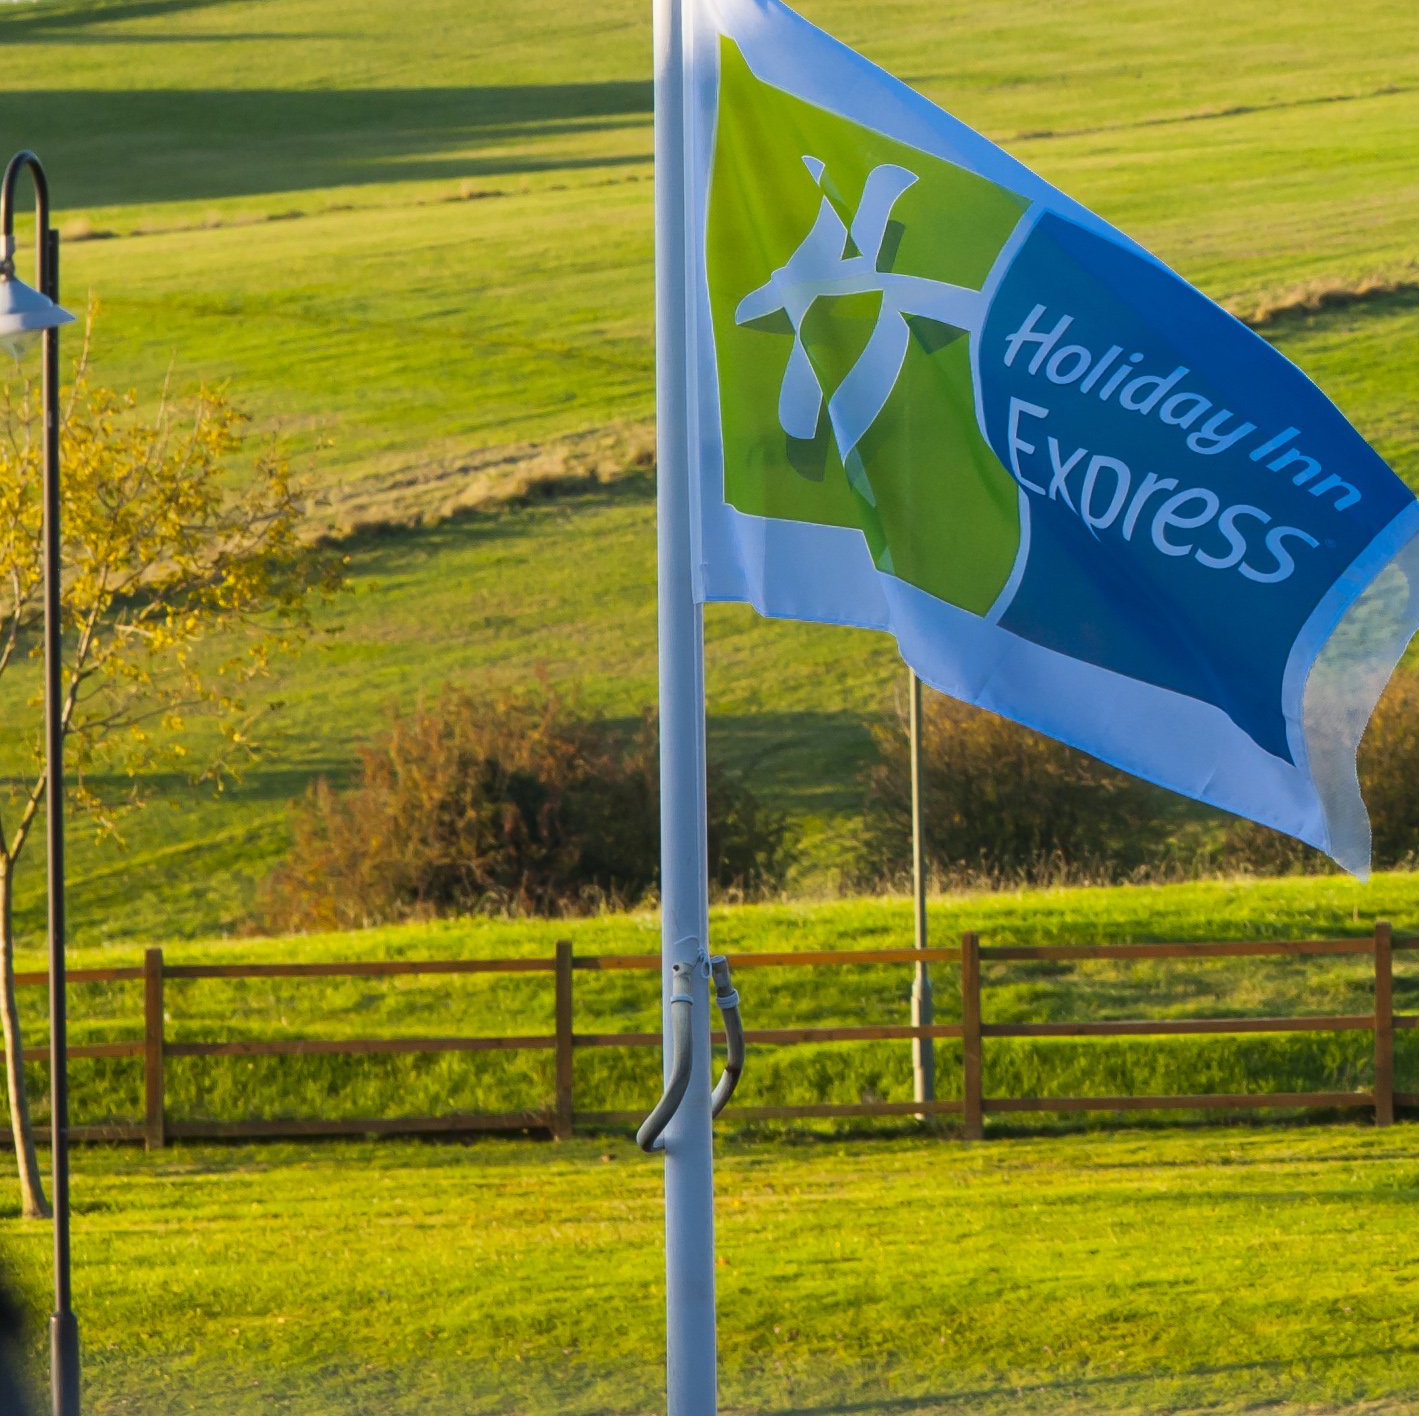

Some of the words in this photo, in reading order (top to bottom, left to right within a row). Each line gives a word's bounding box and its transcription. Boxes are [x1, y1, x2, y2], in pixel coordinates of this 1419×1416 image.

[1003, 304, 1256, 455] Holiday
[1249, 426, 1362, 512] Inn
[1008, 396, 1320, 583] Express
